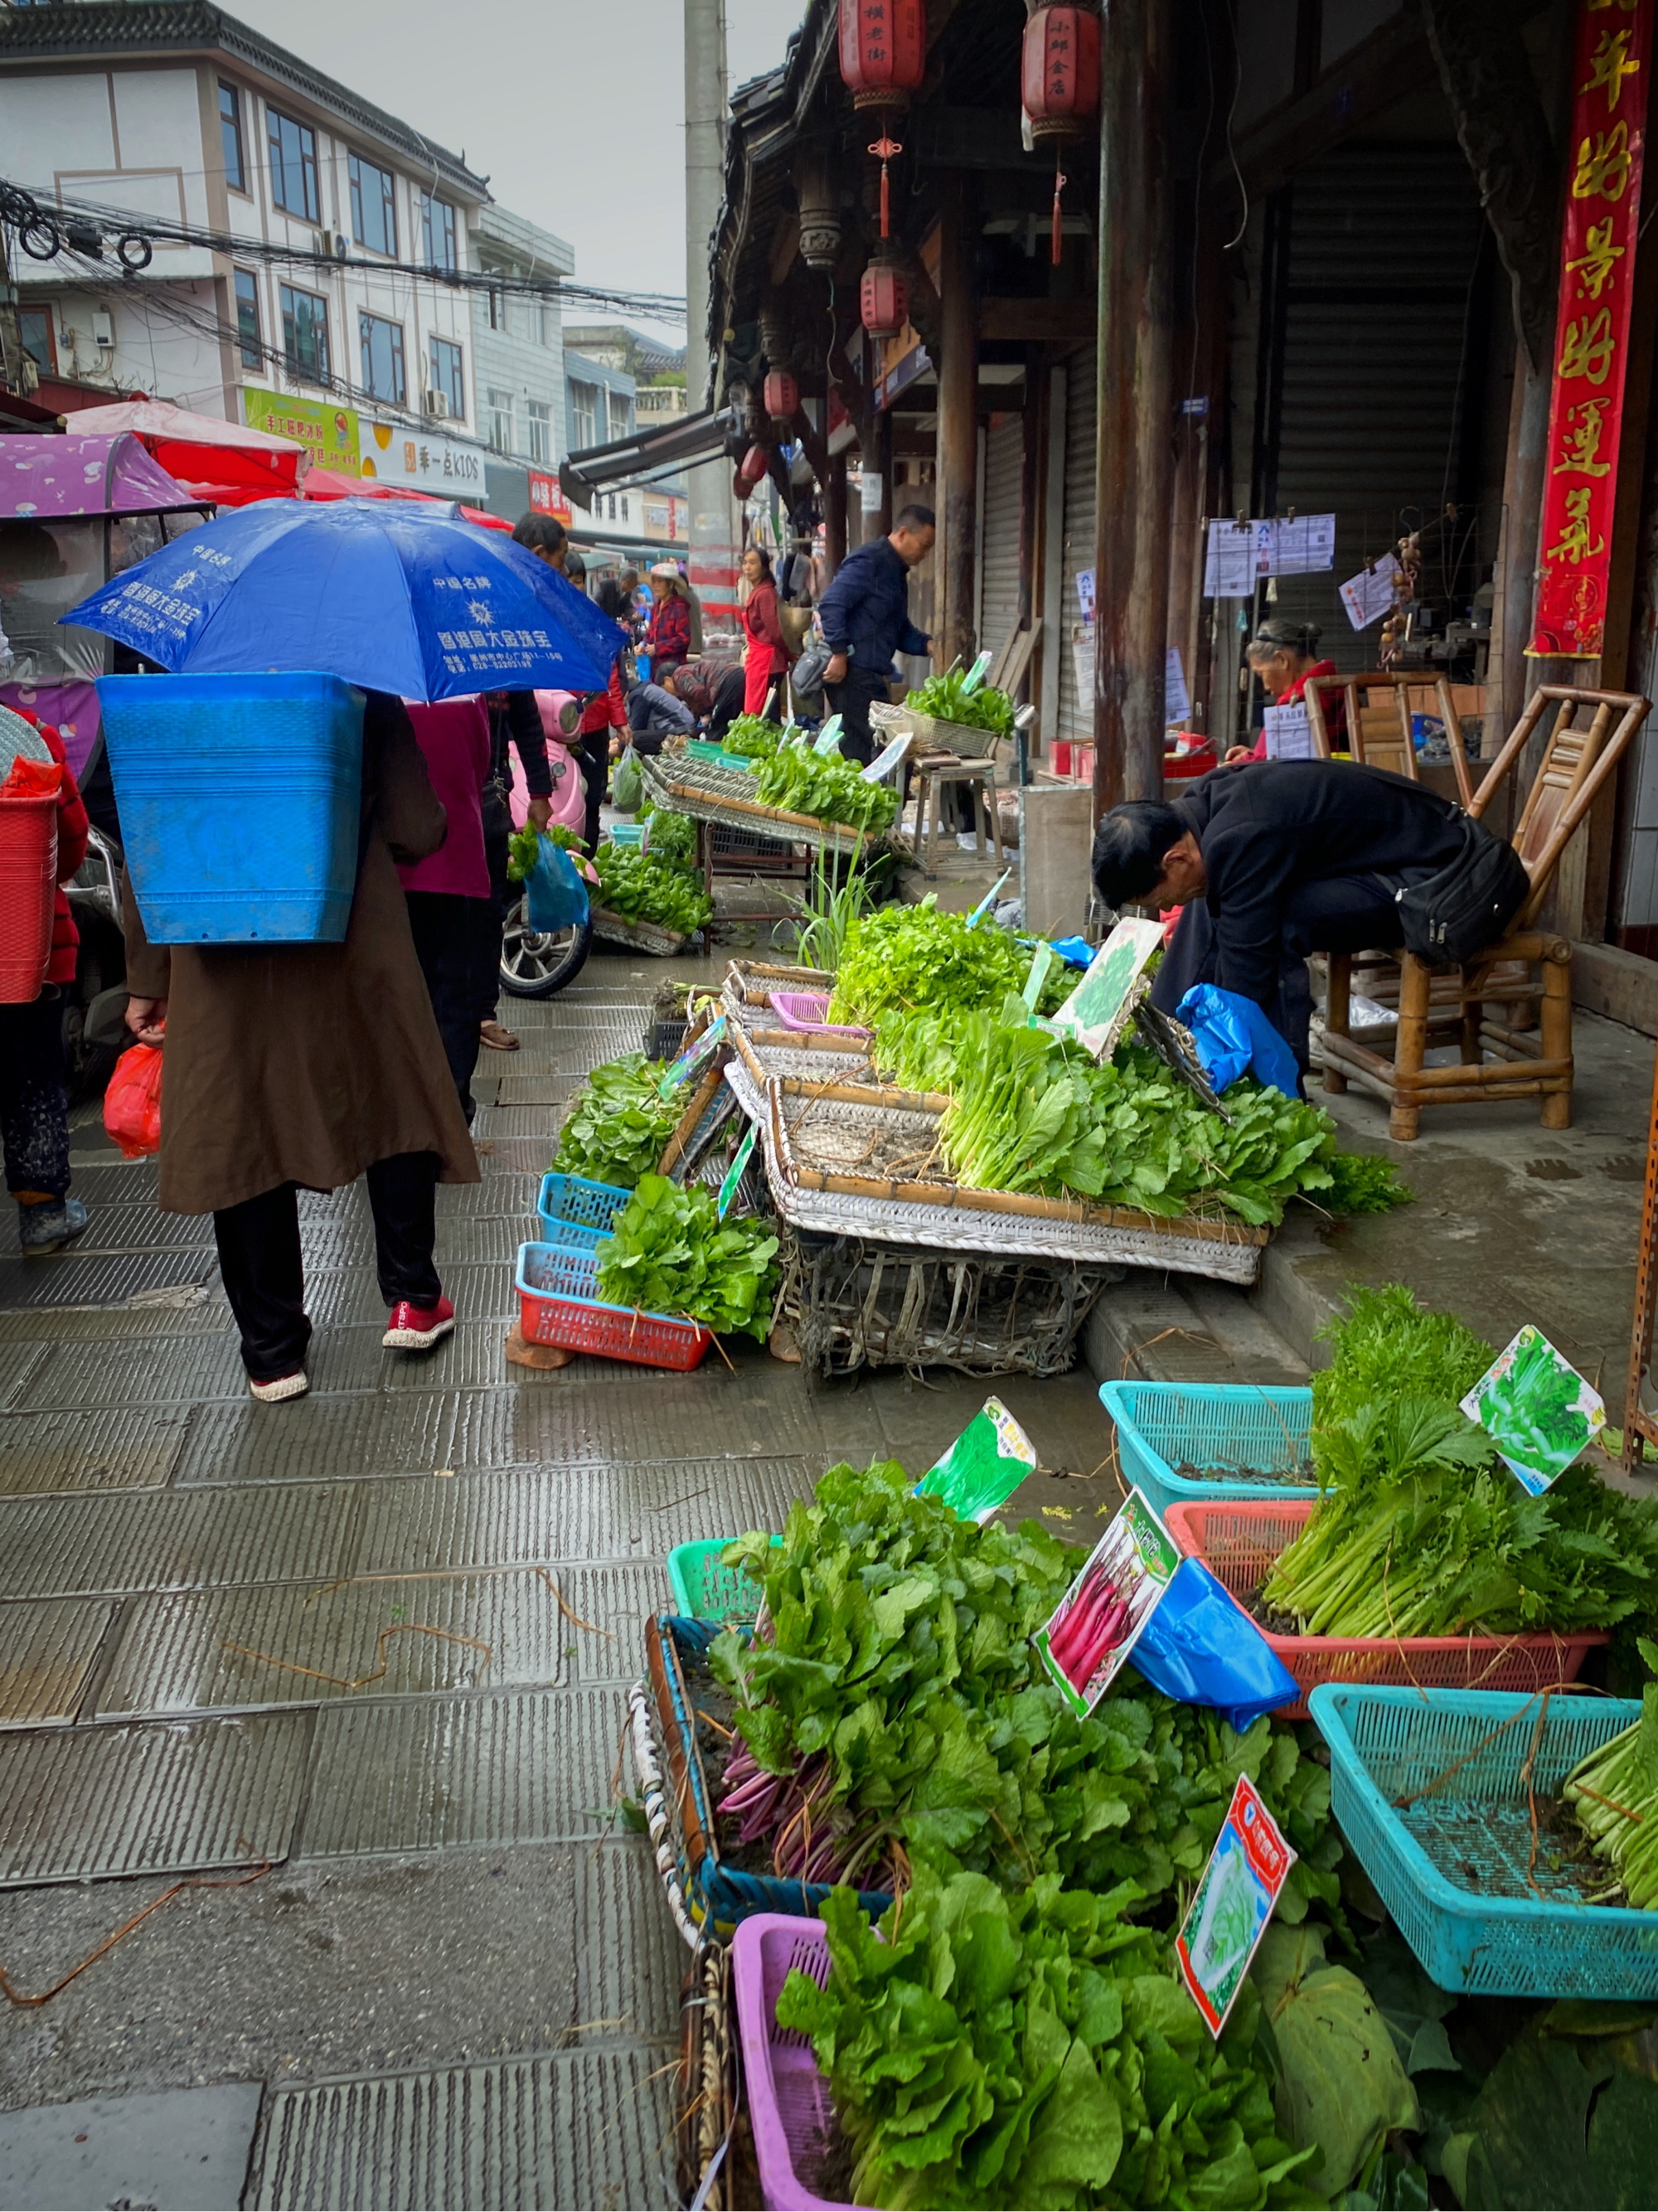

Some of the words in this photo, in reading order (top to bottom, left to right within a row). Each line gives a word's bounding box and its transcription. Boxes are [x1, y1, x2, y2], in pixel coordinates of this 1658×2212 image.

[433, 576, 492, 589] 中国名牌
[121, 581, 201, 626] 香港周大金珠宝
[437, 630, 553, 650] 香港周大金珠宝
